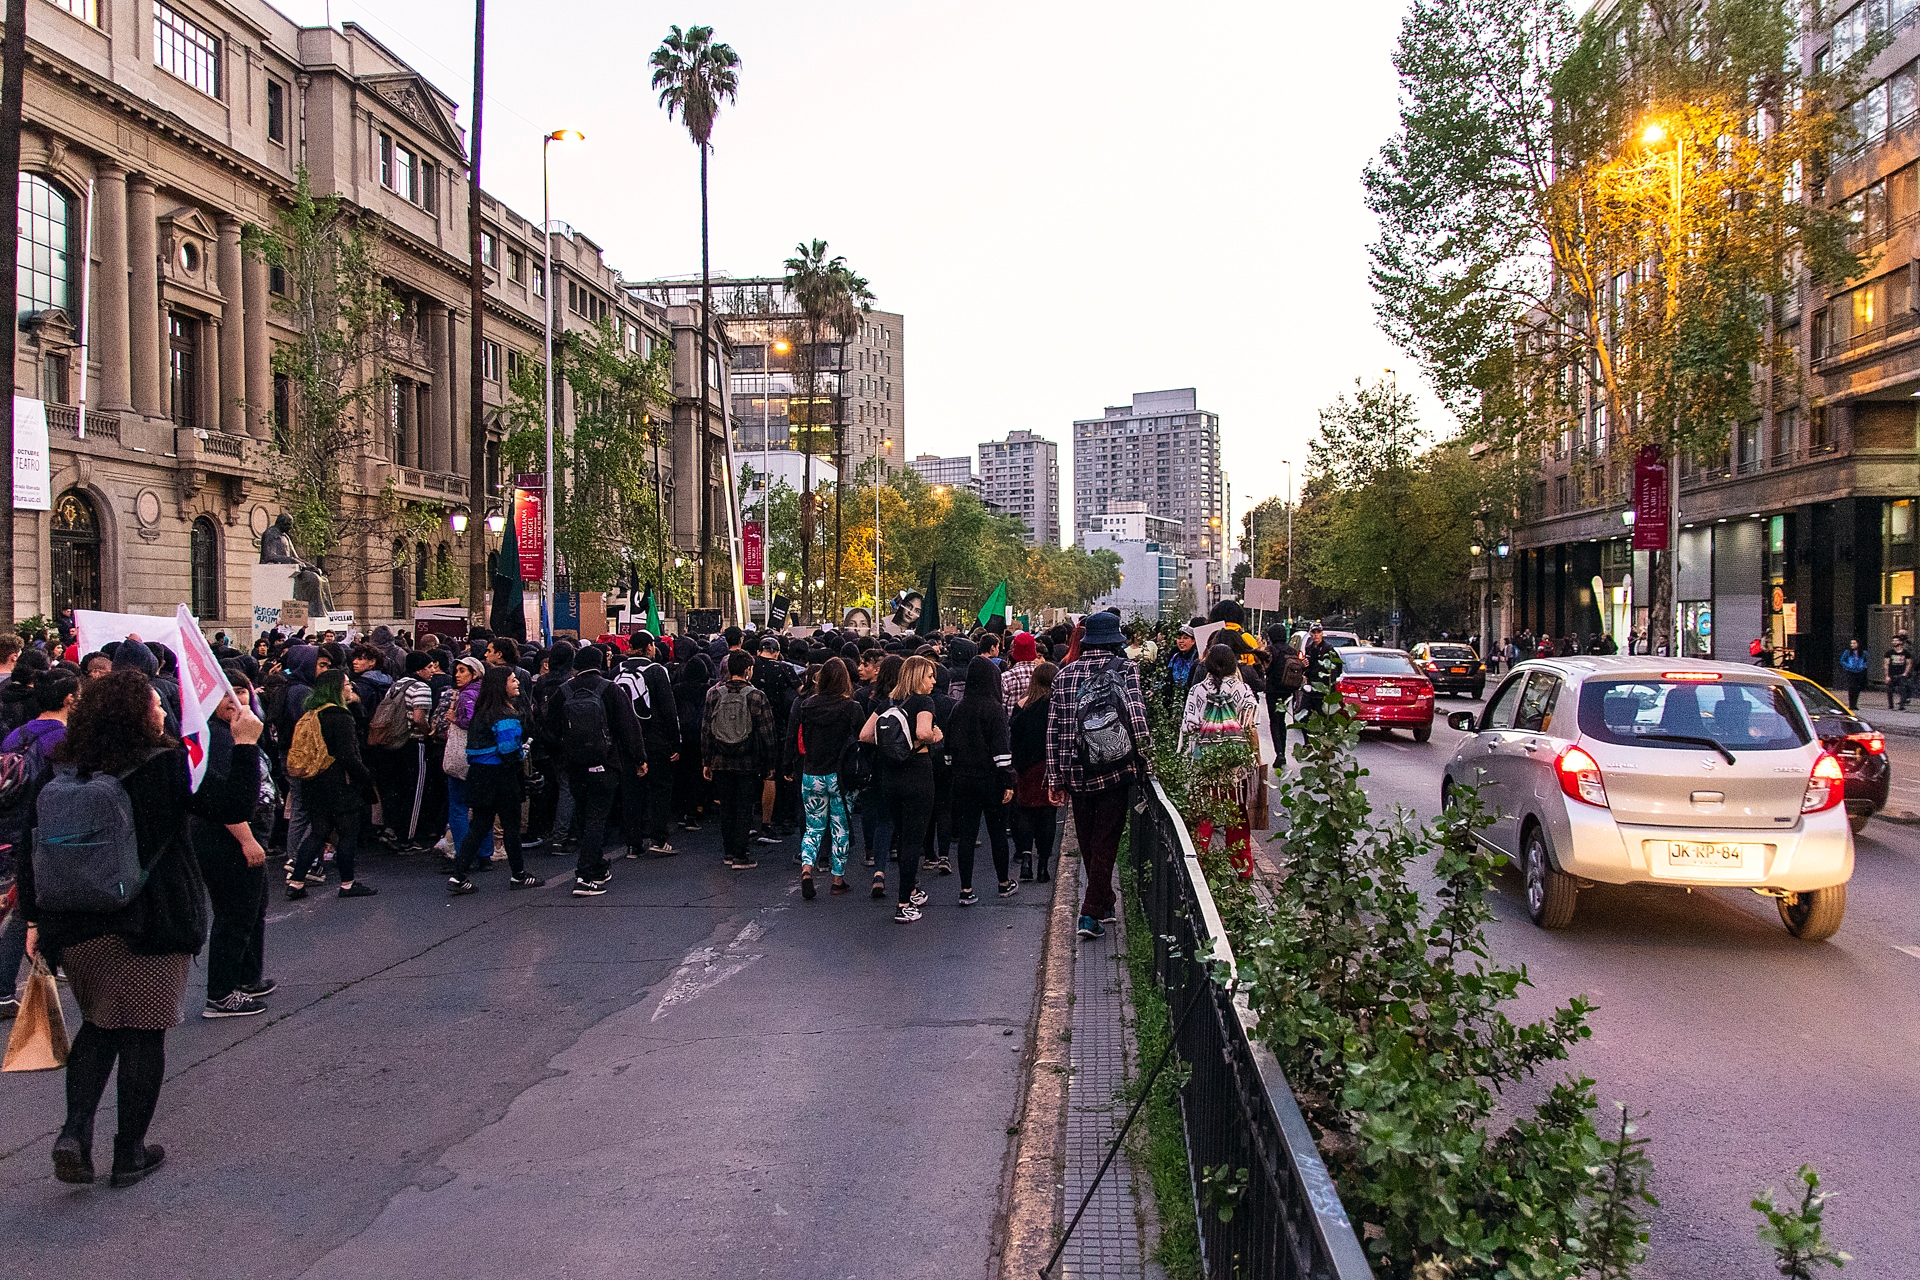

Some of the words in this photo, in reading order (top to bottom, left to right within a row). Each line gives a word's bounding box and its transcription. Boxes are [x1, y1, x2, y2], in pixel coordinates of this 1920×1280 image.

[18, 448, 40, 456] OCTUBRE
[15, 457, 40, 472] TEATRO
[522, 540, 527, 549] LA
[528, 540, 533, 549] EN
